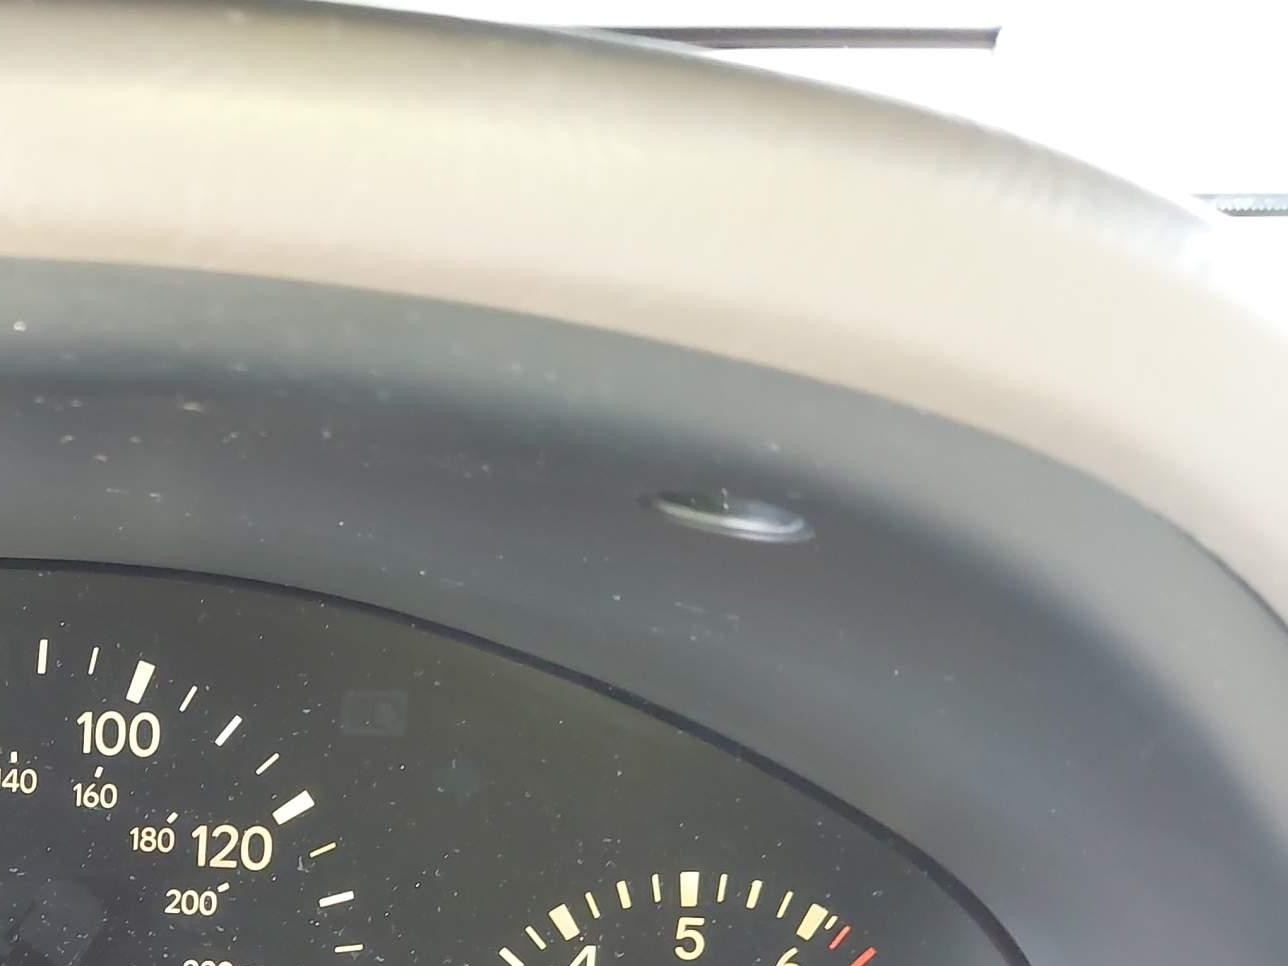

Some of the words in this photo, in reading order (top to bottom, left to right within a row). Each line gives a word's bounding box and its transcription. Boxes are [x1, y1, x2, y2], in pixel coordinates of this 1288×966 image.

[77, 711, 160, 757] 100
[73, 783, 117, 809] 160
[130, 827, 175, 852] 180
[192, 826, 273, 871] 120
[165, 890, 217, 915] 200
[674, 917, 705, 961] 5
